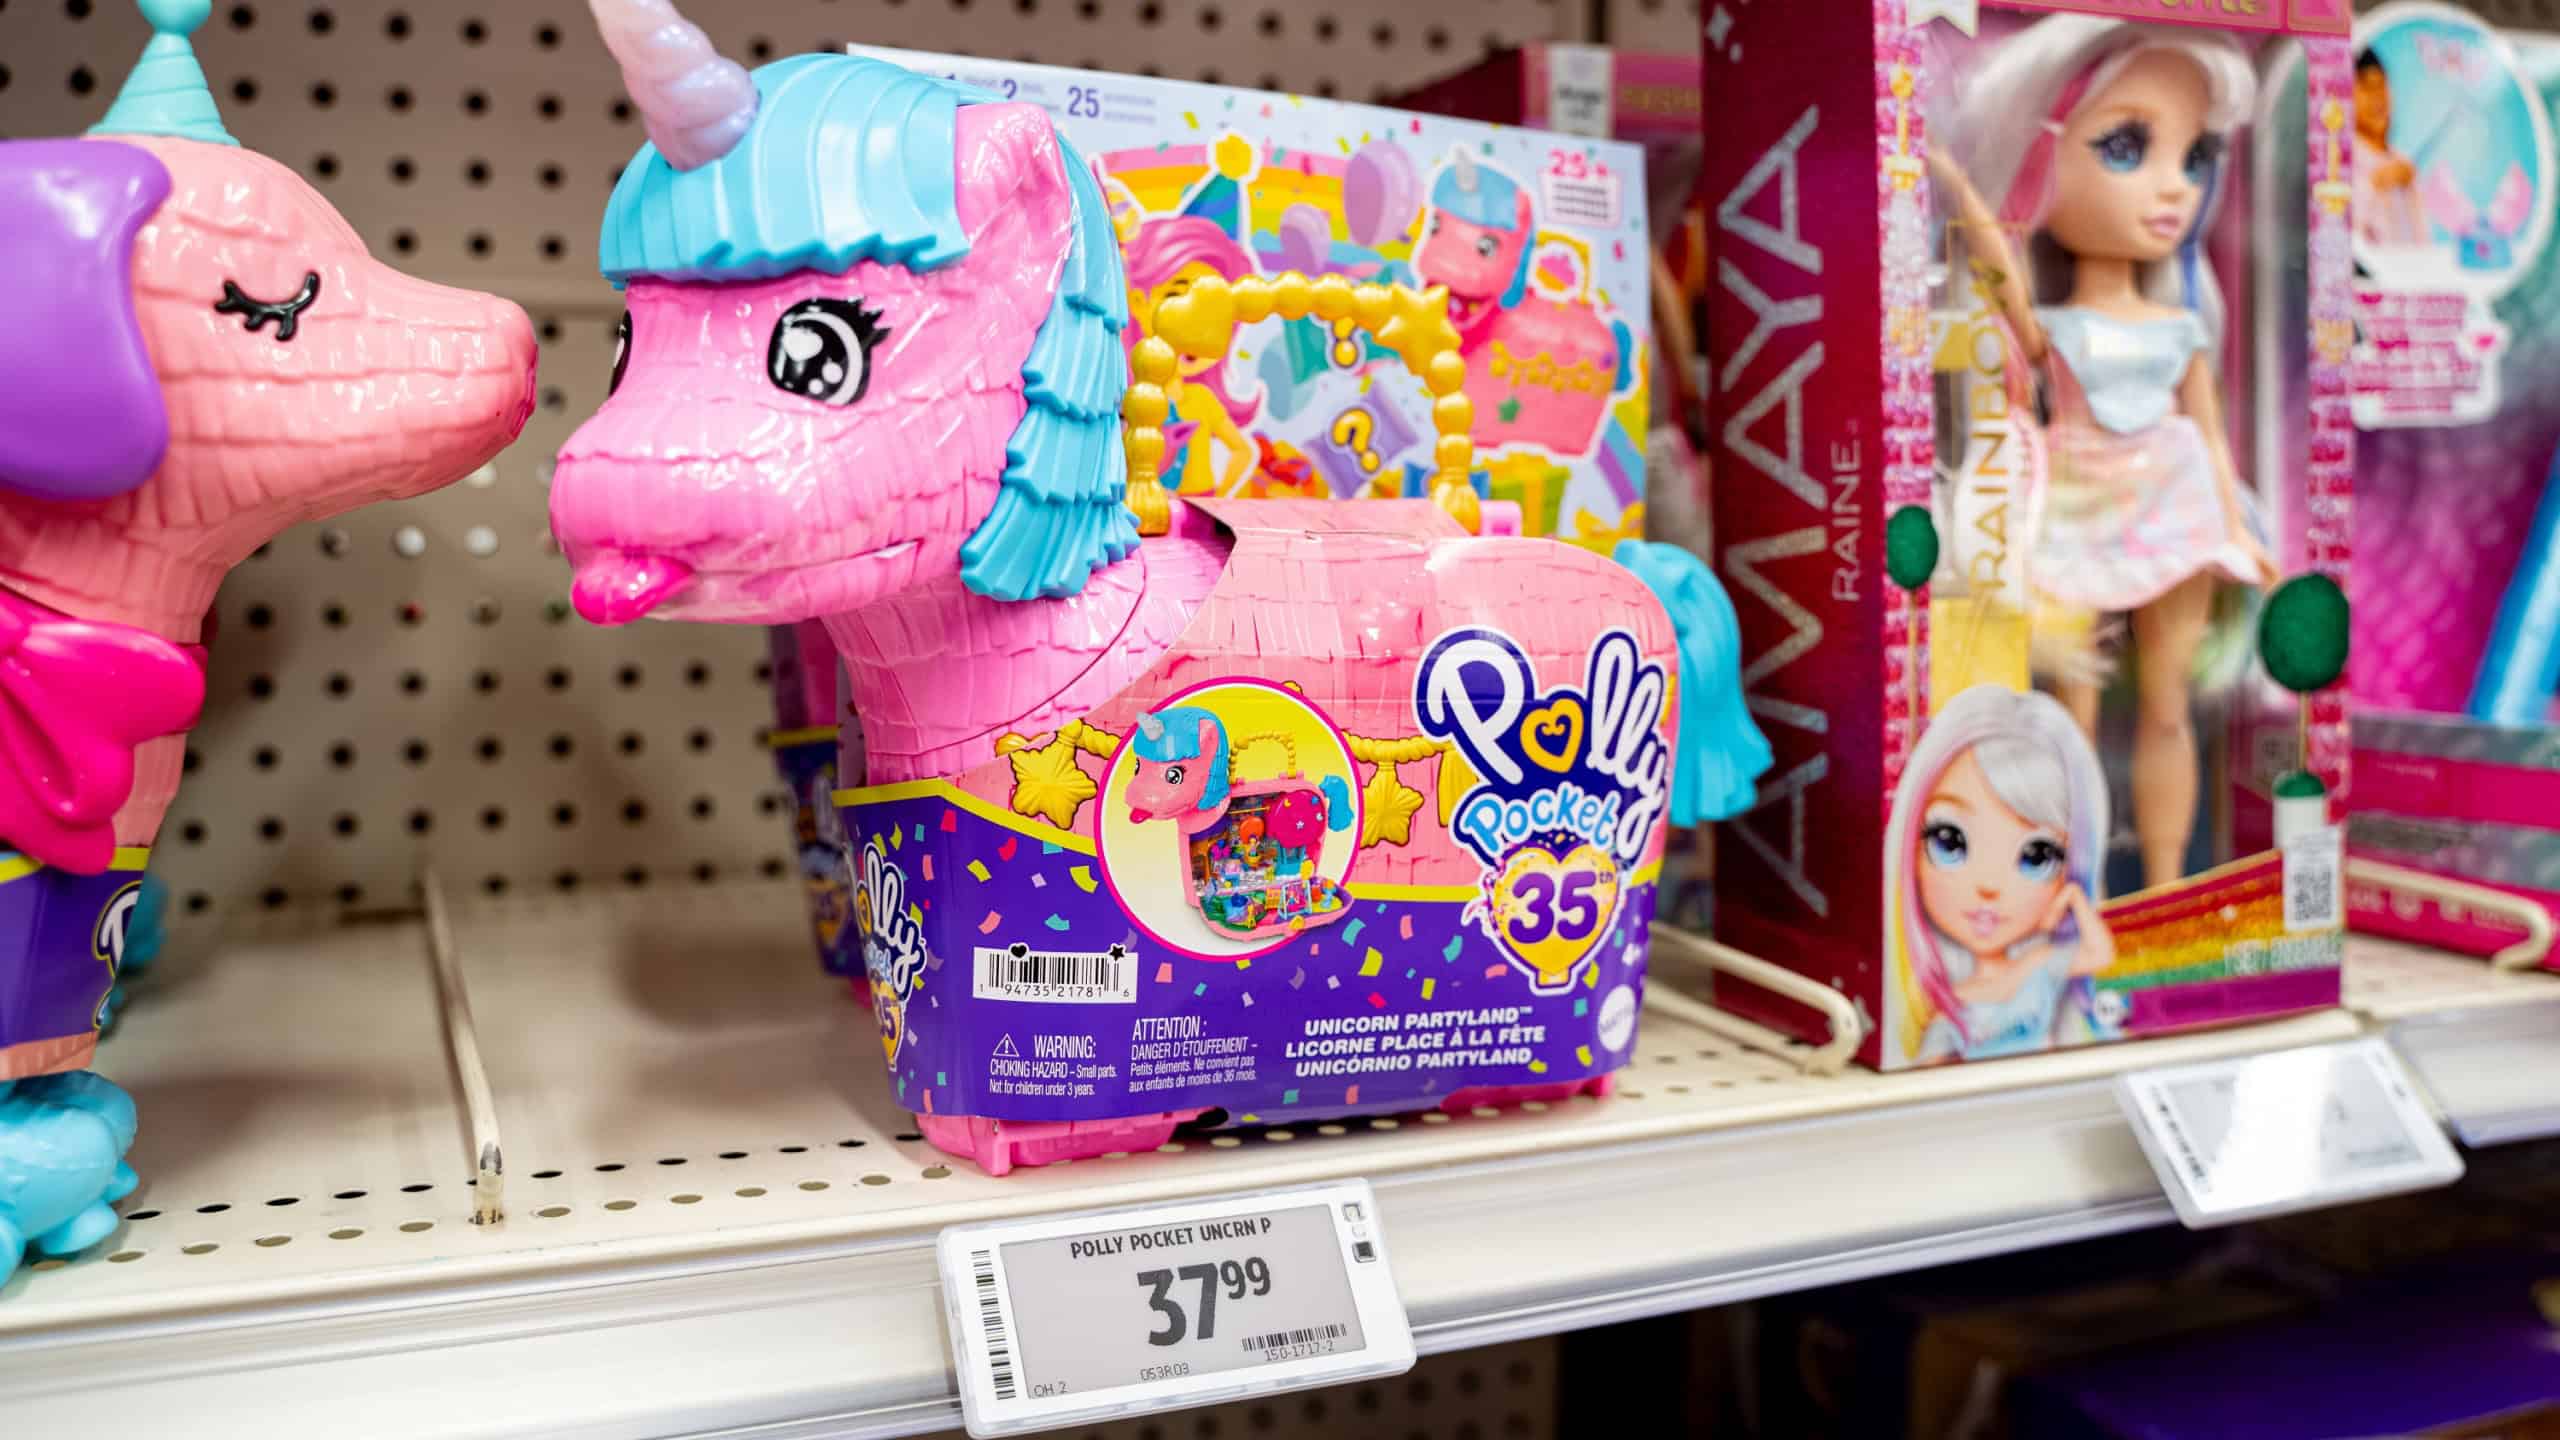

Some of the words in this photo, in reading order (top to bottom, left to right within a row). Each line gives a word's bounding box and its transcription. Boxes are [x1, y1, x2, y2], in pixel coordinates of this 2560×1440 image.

[1067, 84, 1100, 118] 25
[1968, 256, 2009, 590] RAINBOW
[1831, 437, 1862, 601] RAINE
[1427, 631, 1669, 858] Polly
[1464, 784, 1619, 853] Pocket
[1004, 984, 1050, 997] 94735
[1057, 986, 1102, 998] 21781
[1123, 989, 1131, 998] 6
[1304, 1014, 1399, 1036] UNICORN
[1034, 1034, 1096, 1059] WARNING:
[1131, 1042, 1171, 1060] DANGER
[1285, 1037, 1375, 1058] LICORNE
[1381, 1032, 1445, 1051] PLACE
[1450, 1027, 1464, 1046] À
[1469, 1029, 1493, 1045] LA
[1498, 1024, 1546, 1043] FÊTE
[990, 1058, 1030, 1078] CHOKING
[1032, 1061, 1068, 1079] HAZARD
[1076, 1064, 1097, 1079] Small
[1130, 1062, 1153, 1077] Petits
[1194, 1057, 1205, 1070] Ne
[1206, 1055, 1239, 1070] convient
[1240, 1055, 1255, 1069] pas
[1295, 1053, 1411, 1077] UNICÓRNIO
[1415, 1048, 1532, 1069] PARTYLAND
[989, 1078, 1004, 1094] Not
[1015, 1081, 1044, 1096] children
[1045, 1083, 1065, 1096] under
[1067, 1083, 1073, 1096] 3
[1129, 1080, 1144, 1093] aux
[1145, 1075, 1174, 1091] enfants
[1175, 1074, 1185, 1088] de
[1186, 1071, 1212, 1086] moins
[1213, 1070, 1222, 1084] de
[1223, 1069, 1234, 1083] 36
[1070, 1236, 1123, 1259] POLLY
[1130, 1227, 1194, 1251] POCKET
[1199, 1219, 1257, 1242] UNCRN
[1261, 1217, 1272, 1234] P
[1265, 1340, 1335, 1362] 150-1717-2
